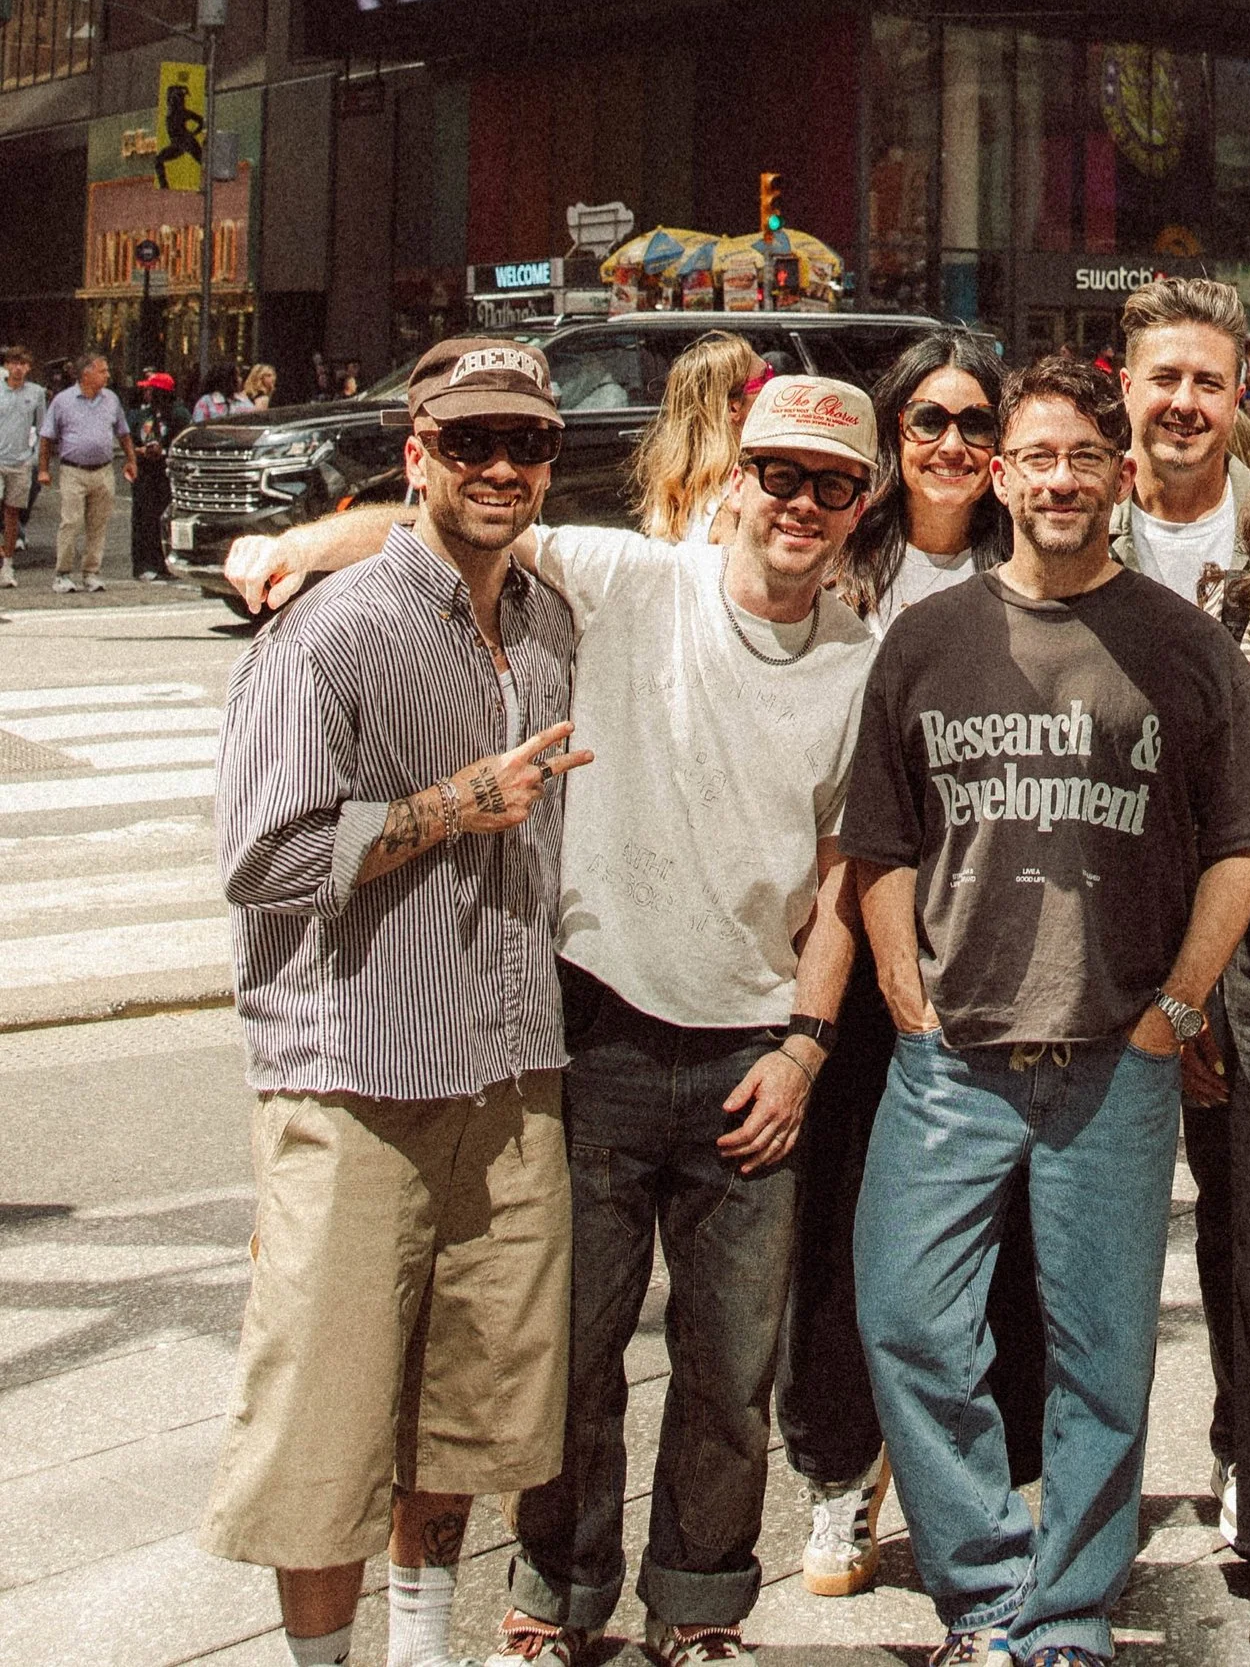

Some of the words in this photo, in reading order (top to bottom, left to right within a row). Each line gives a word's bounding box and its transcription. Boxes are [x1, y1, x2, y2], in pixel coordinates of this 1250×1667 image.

[495, 262, 550, 288] WELCOME
[1076, 266, 1154, 291] swatch
[773, 384, 818, 408] The
[813, 394, 860, 426] Chorus
[919, 699, 1092, 769] Research
[1130, 713, 1163, 774] &
[931, 762, 1151, 836] Development
